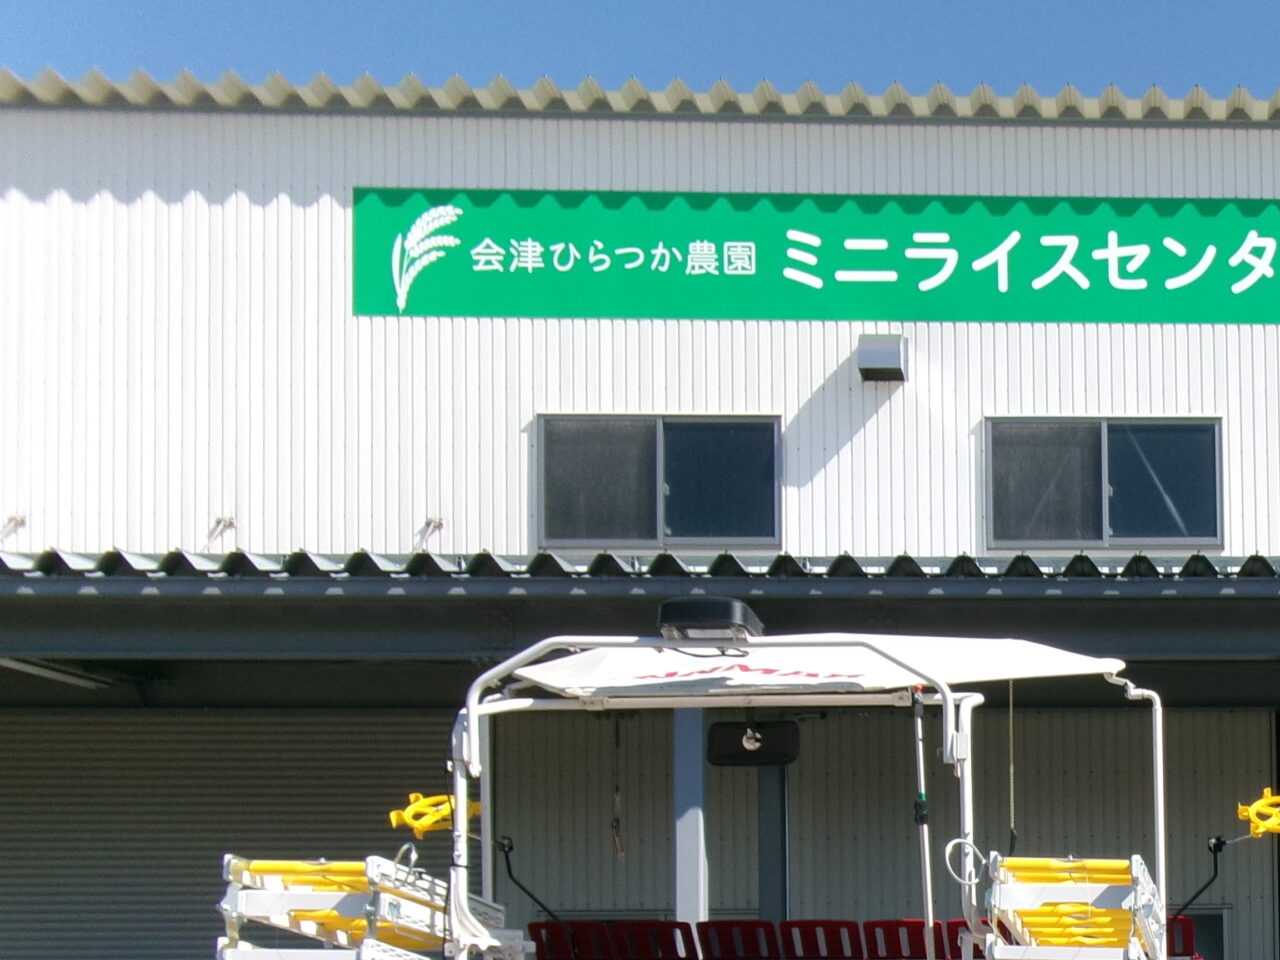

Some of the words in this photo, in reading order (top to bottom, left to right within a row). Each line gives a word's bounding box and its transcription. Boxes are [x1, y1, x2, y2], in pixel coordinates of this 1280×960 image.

[470, 237, 756, 275] 会津ひらつか農園
